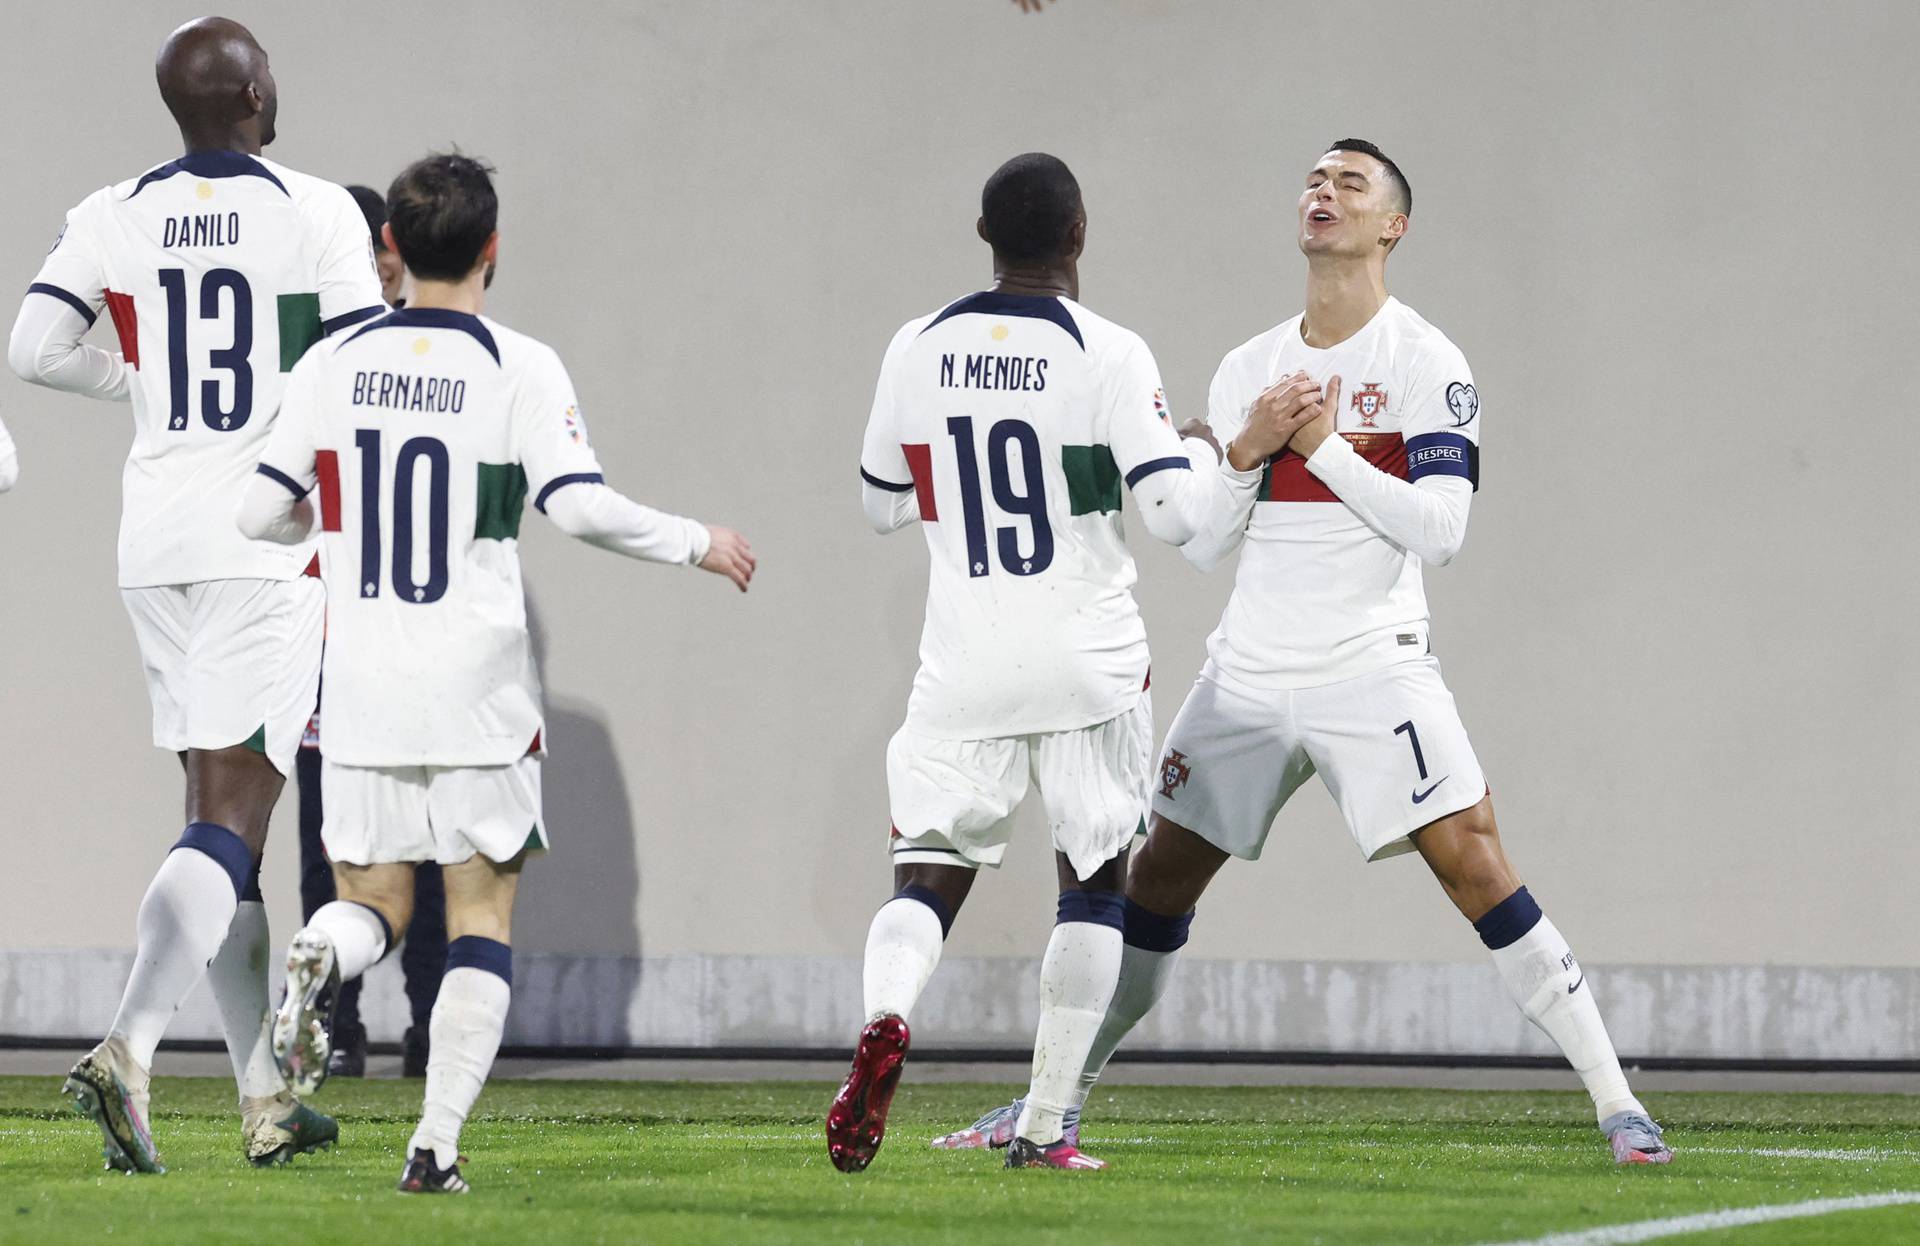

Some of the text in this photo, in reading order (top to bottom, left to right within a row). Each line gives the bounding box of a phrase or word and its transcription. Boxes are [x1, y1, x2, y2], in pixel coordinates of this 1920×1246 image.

[164, 212, 239, 248] DANILO
[158, 268, 254, 432] 13
[353, 372, 466, 414] BERNARDO
[1417, 448, 1462, 461] RESPECT
[356, 429, 450, 604] 10
[947, 416, 1054, 577] 19
[1393, 720, 1429, 781] 7
